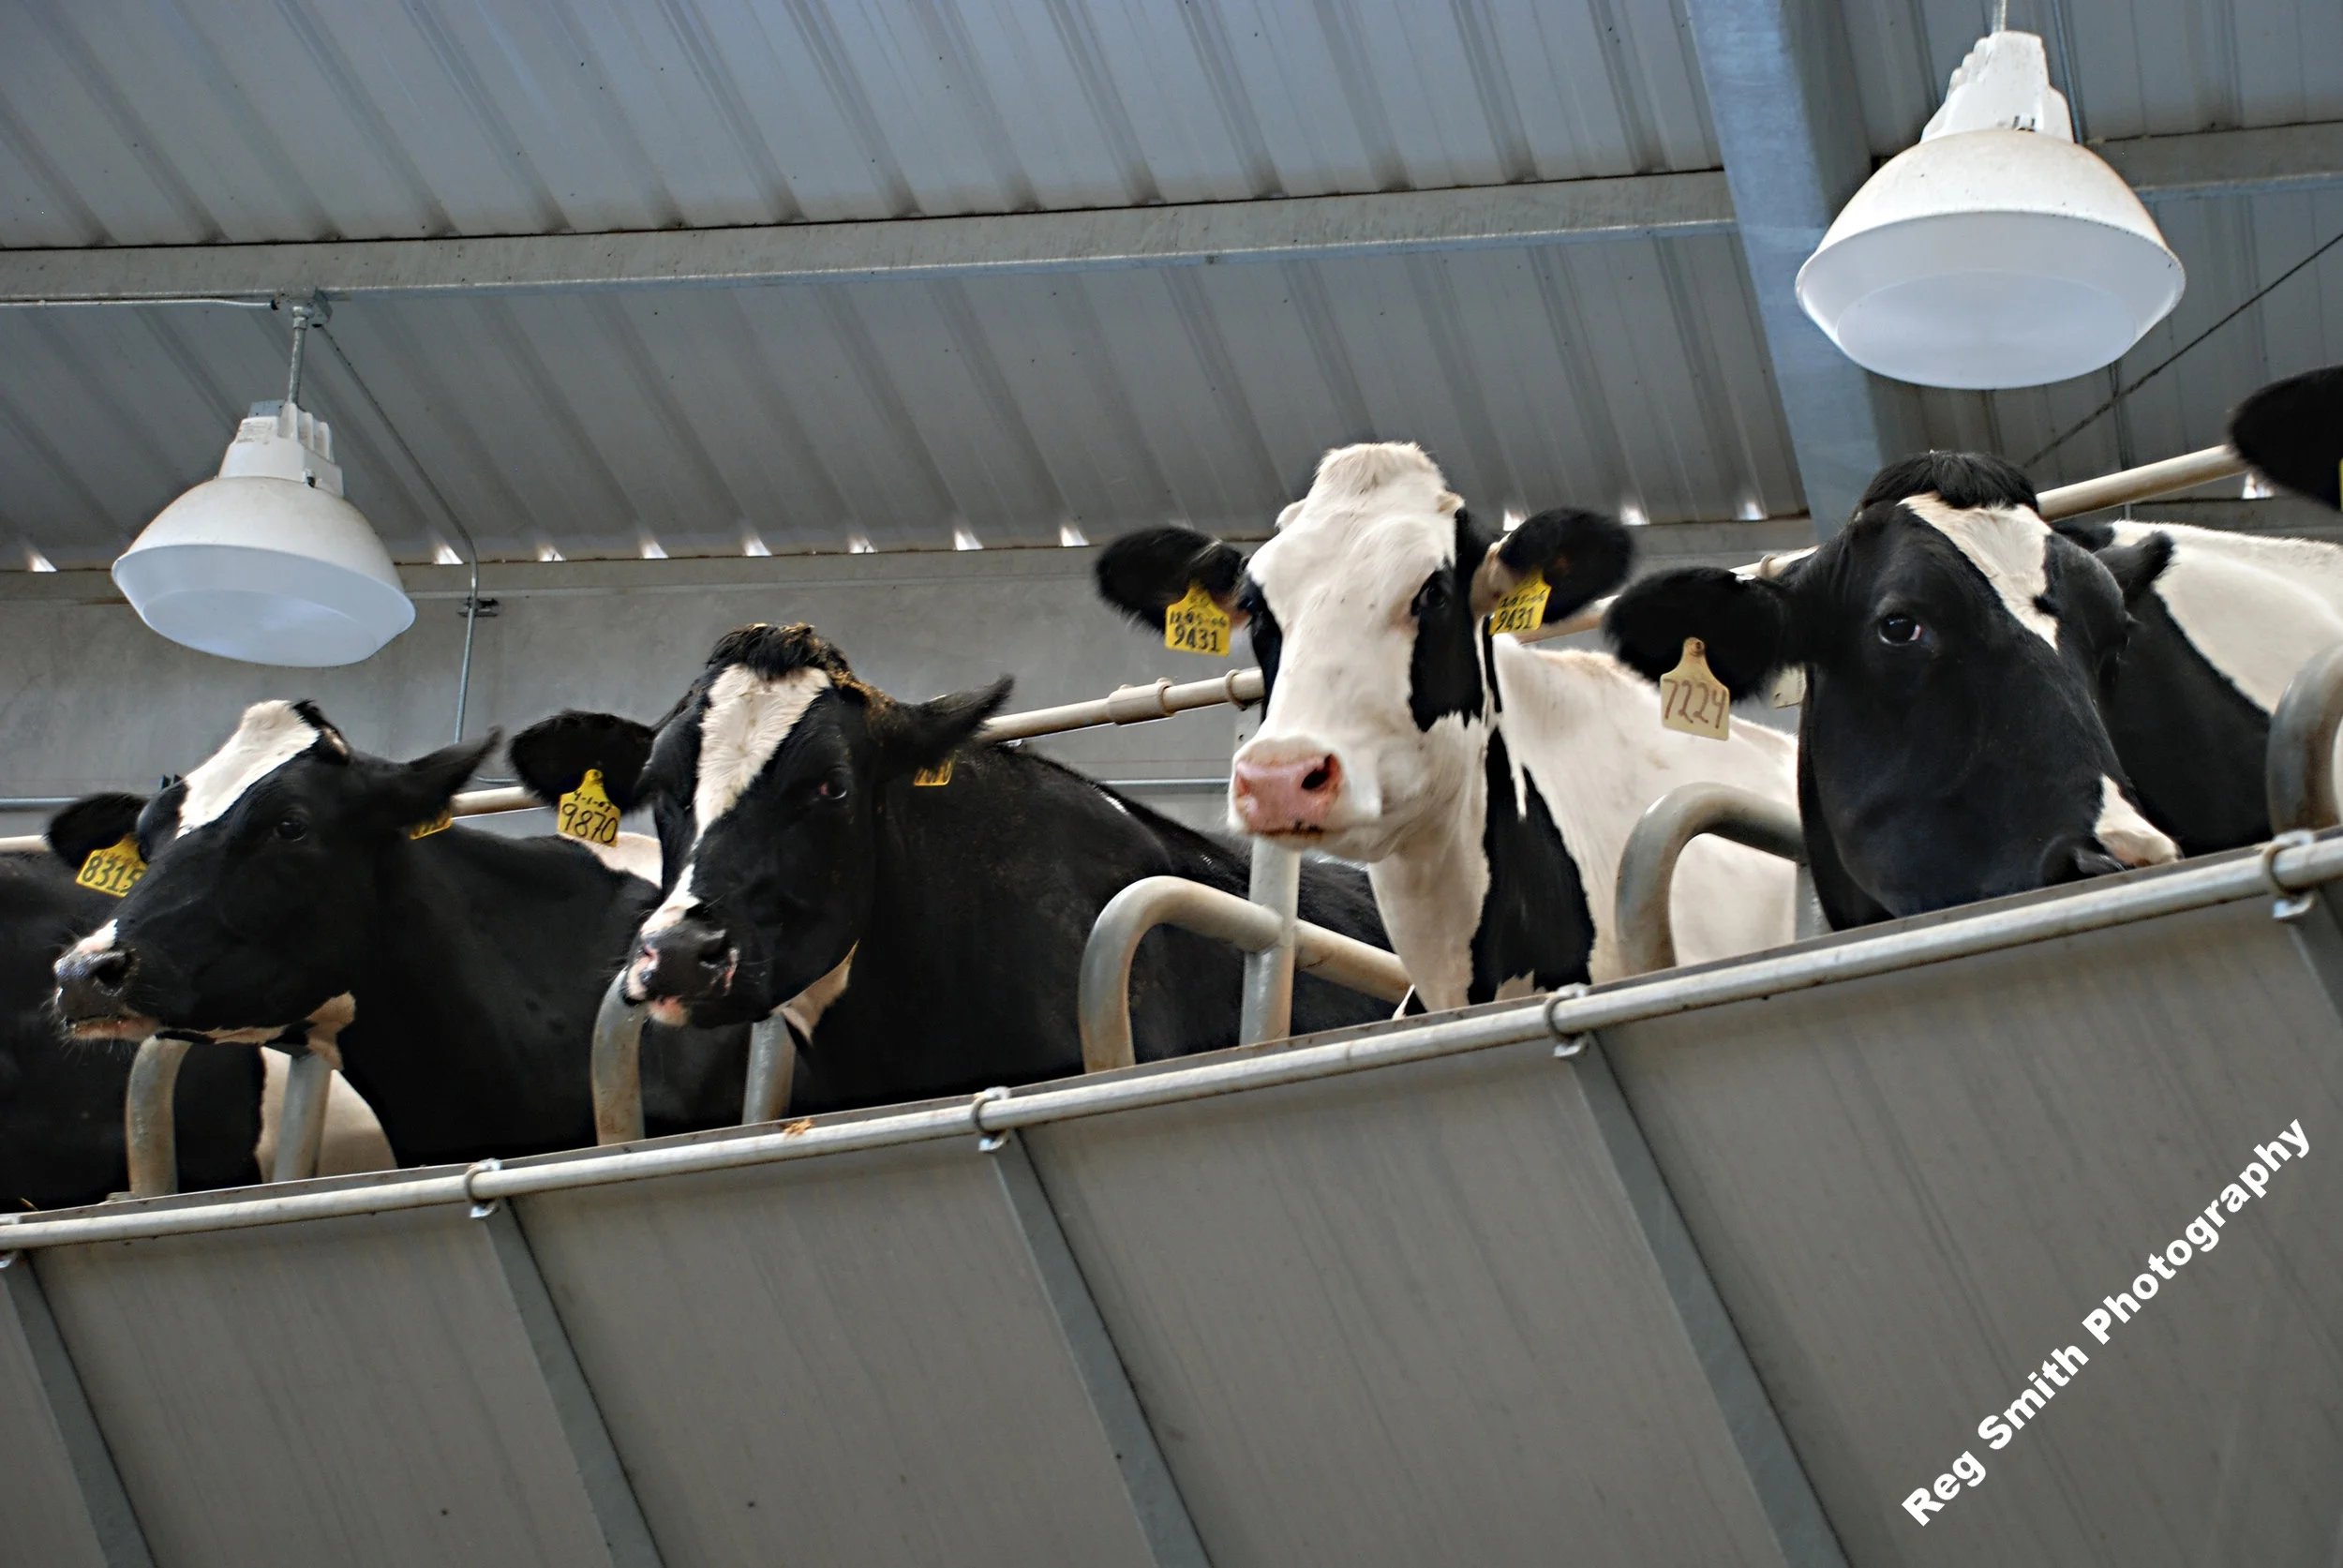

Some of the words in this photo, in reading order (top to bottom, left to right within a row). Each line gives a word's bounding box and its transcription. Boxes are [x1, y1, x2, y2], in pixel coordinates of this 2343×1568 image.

[1495, 606, 1534, 633] 9431
[1174, 624, 1220, 652] 9431
[1663, 678, 1726, 729] 7224
[562, 802, 618, 844] 9870
